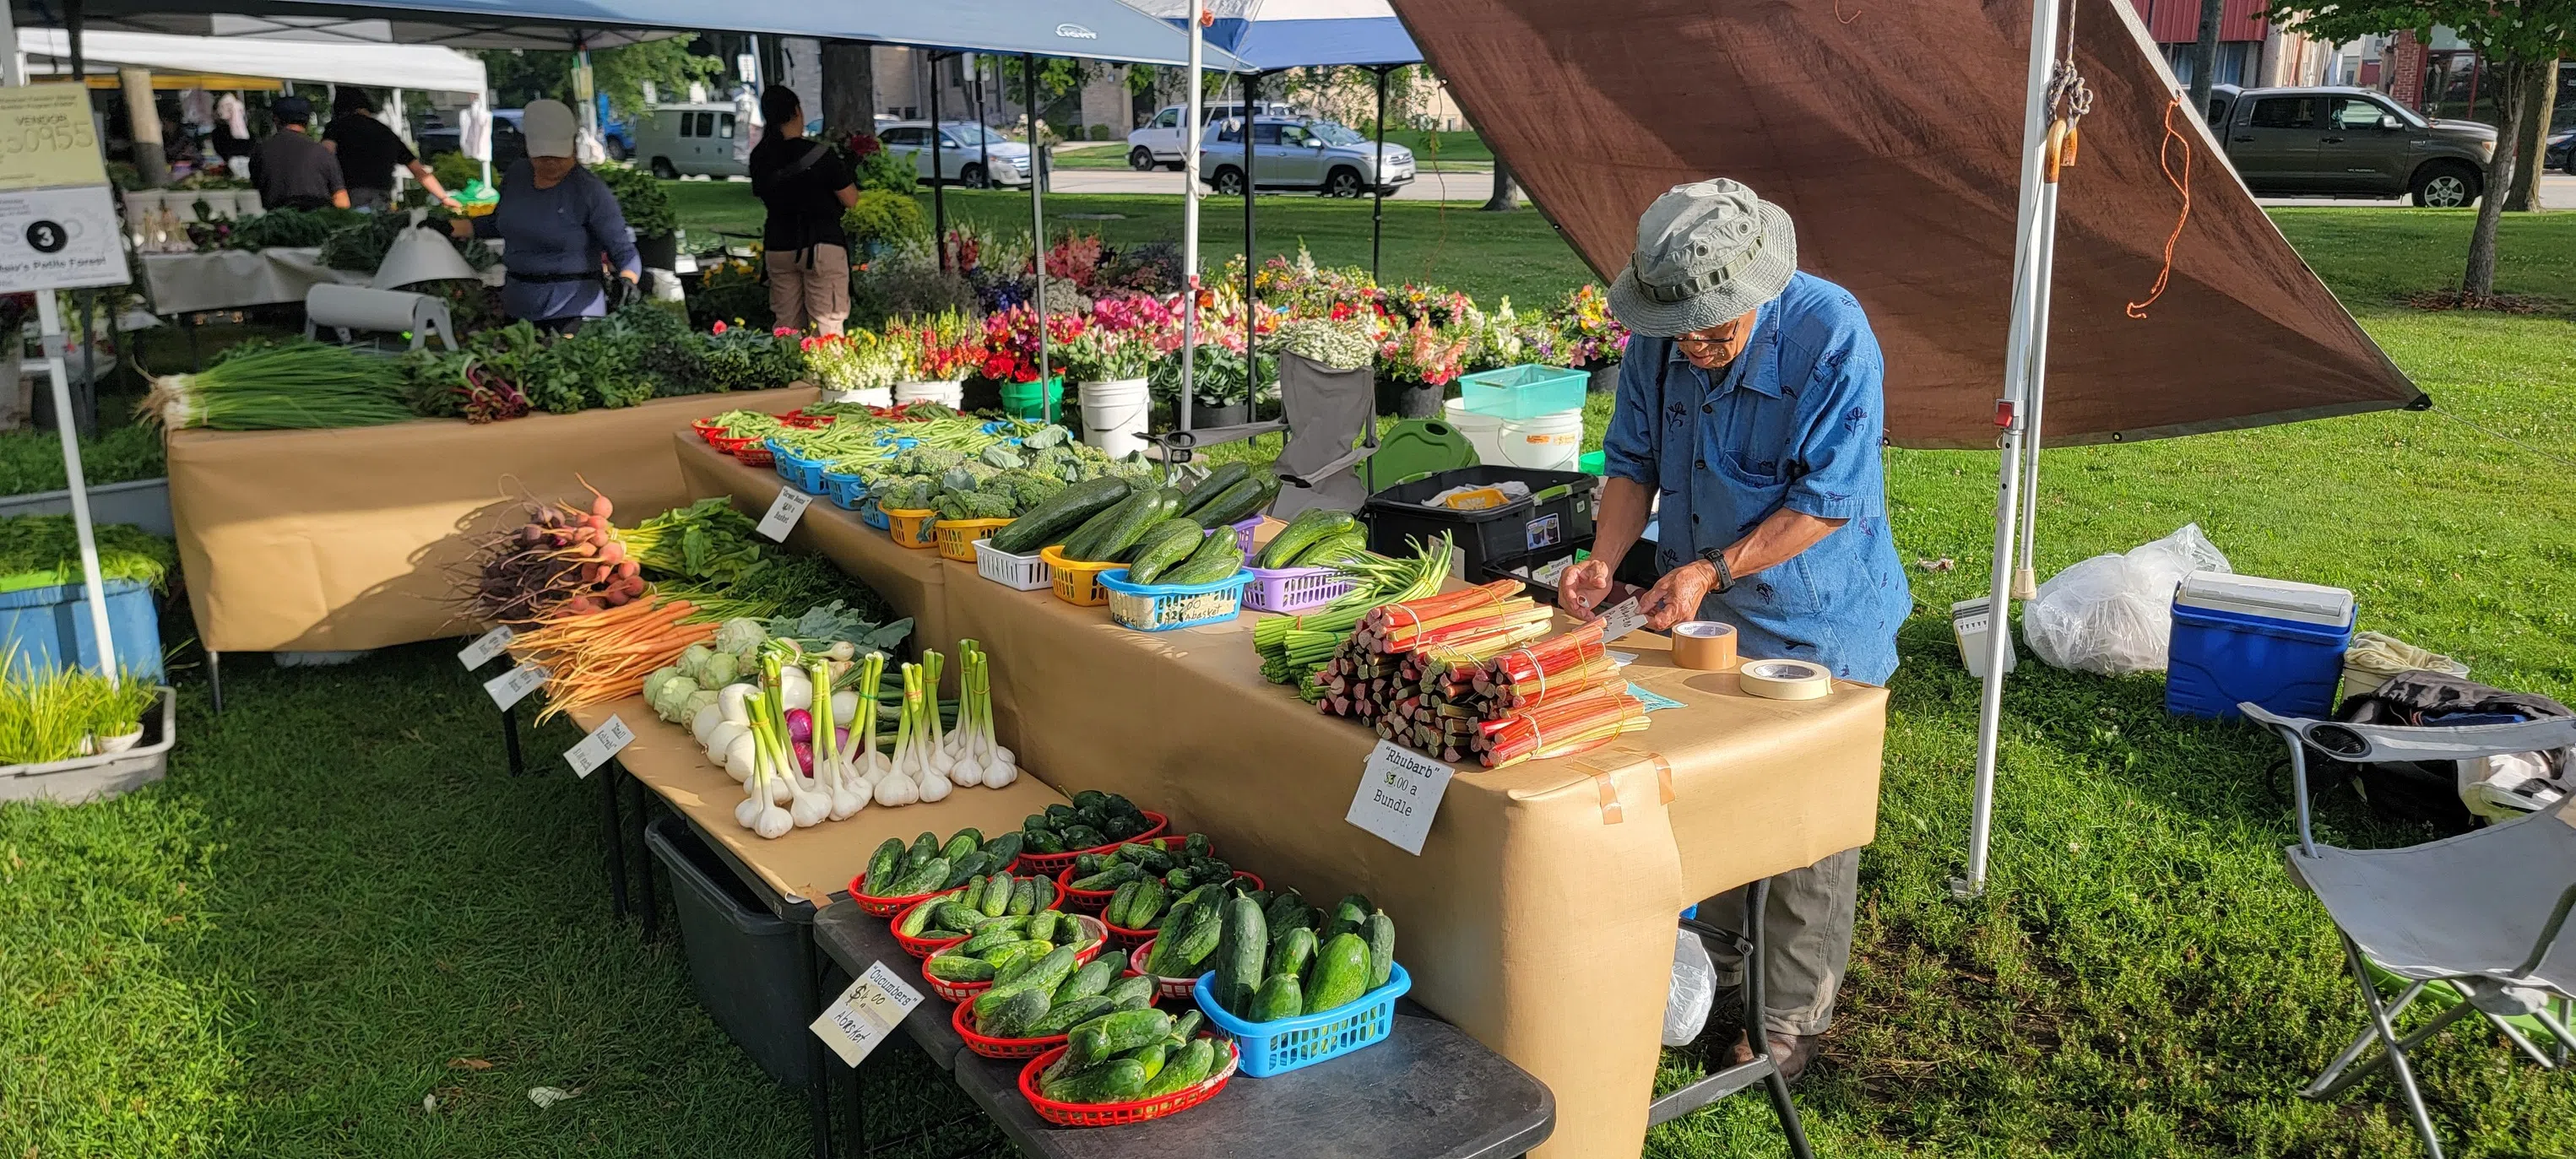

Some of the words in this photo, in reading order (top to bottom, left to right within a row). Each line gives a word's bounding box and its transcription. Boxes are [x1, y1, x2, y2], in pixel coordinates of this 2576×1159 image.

[15, 113, 68, 126] VENDOR
[36, 226, 55, 247] 3
[1386, 745, 1440, 778] "Rhubarb"
[1373, 788, 1413, 816] Bundle
[1409, 785, 1418, 795] a
[870, 965, 919, 1006] "Cucumbers"
